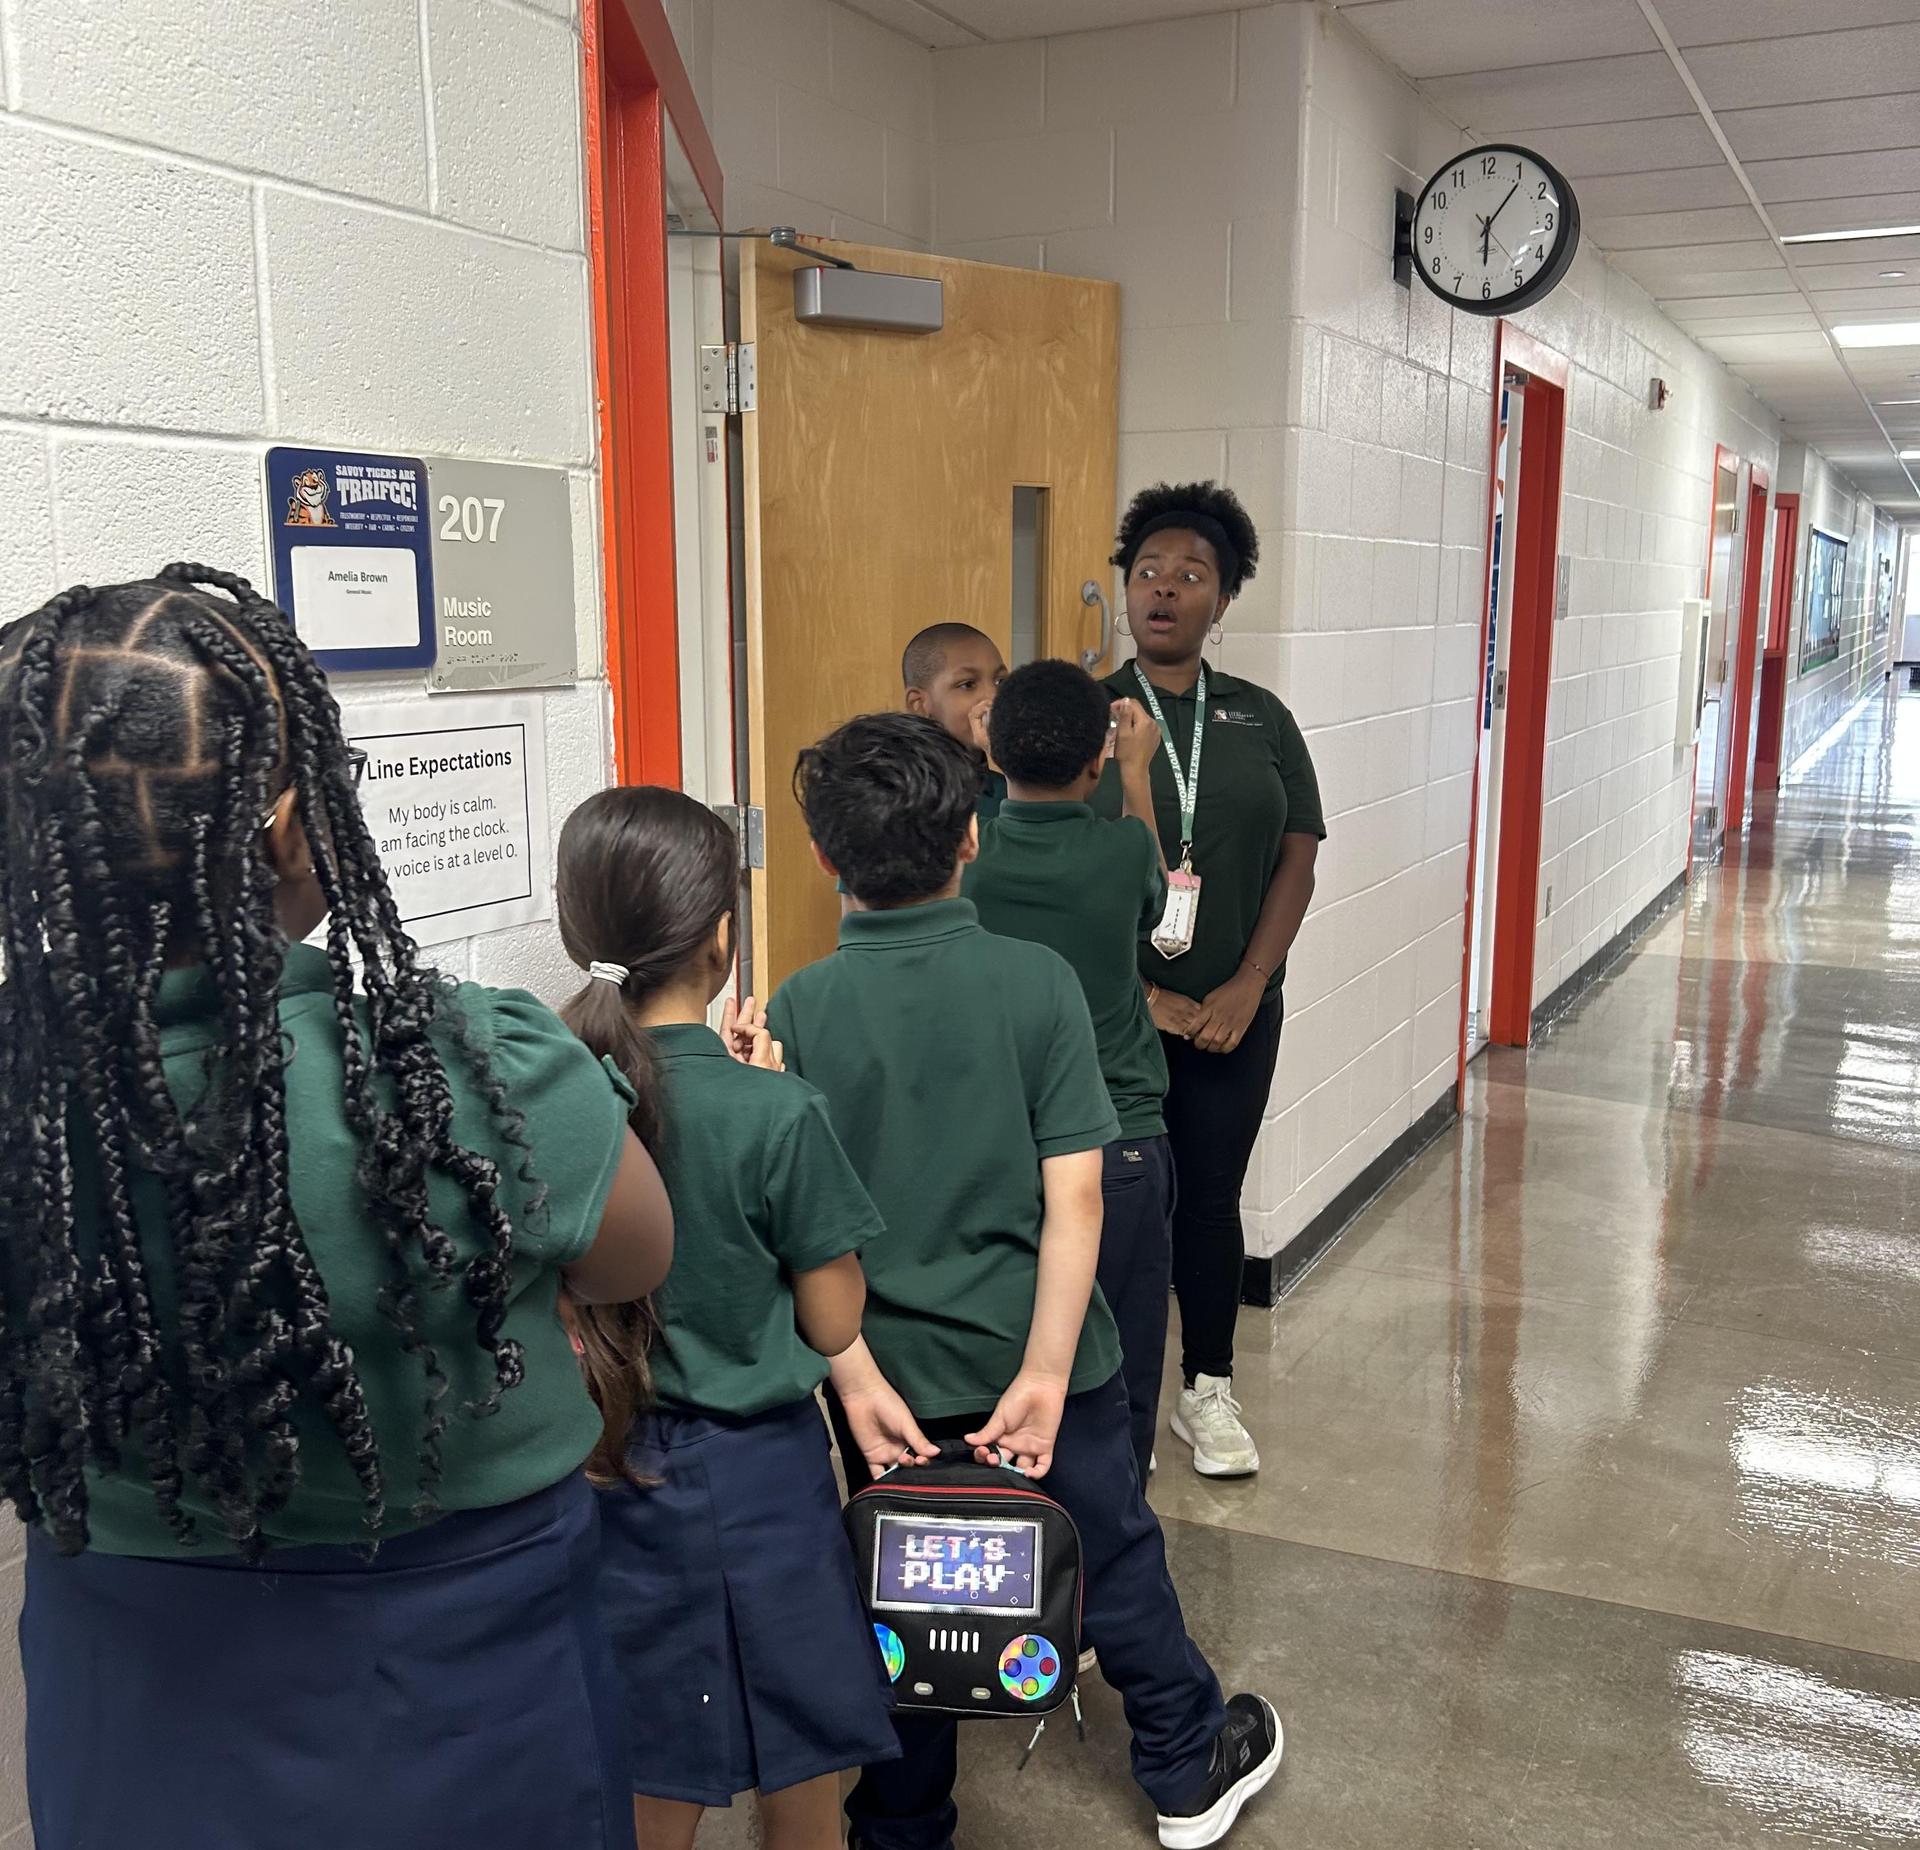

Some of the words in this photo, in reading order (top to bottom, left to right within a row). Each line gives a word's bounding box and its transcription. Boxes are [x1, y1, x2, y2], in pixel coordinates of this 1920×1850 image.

[1480, 156, 1496, 176] 12
[1515, 162, 1523, 180] 1
[1451, 169, 1466, 188] 11
[1430, 191, 1447, 210] 10
[1537, 182, 1547, 200] 2
[1544, 213, 1554, 231] 3
[1424, 226, 1433, 244] 9
[1535, 245, 1545, 262] 4
[1432, 257, 1441, 275] 8
[1453, 276, 1462, 294] 7
[1514, 269, 1523, 288] 5
[1481, 281, 1491, 300] 6
[335, 464, 364, 478] SAVOY
[365, 466, 397, 480] TIGERS
[398, 469, 416, 481] ARE
[336, 477, 417, 511] TRRIFCC!
[438, 494, 506, 543] 207
[328, 570, 359, 582] Amelia
[360, 571, 388, 584] Brown
[443, 597, 492, 618] Music
[444, 626, 493, 647] Room
[1164, 741, 1181, 772] SAVOY
[1189, 720, 1204, 779] ELEMENTARY
[367, 759, 404, 780] Line
[409, 749, 512, 779] Expectations
[1186, 780, 1198, 814] SAVOY
[389, 807, 410, 827] My
[413, 801, 447, 822] body
[450, 799, 461, 815] is
[463, 795, 497, 814] calm.
[381, 838, 402, 853] am
[406, 829, 447, 848] facing
[449, 825, 471, 842] the
[473, 818, 510, 839] clock.
[394, 858, 431, 877] voice
[433, 855, 445, 871] is
[447, 853, 460, 869] at
[463, 853, 471, 866] a
[473, 843, 503, 864] level
[900, 1534, 1009, 1562] LET'S
[899, 1560, 1014, 1592] PLAY
